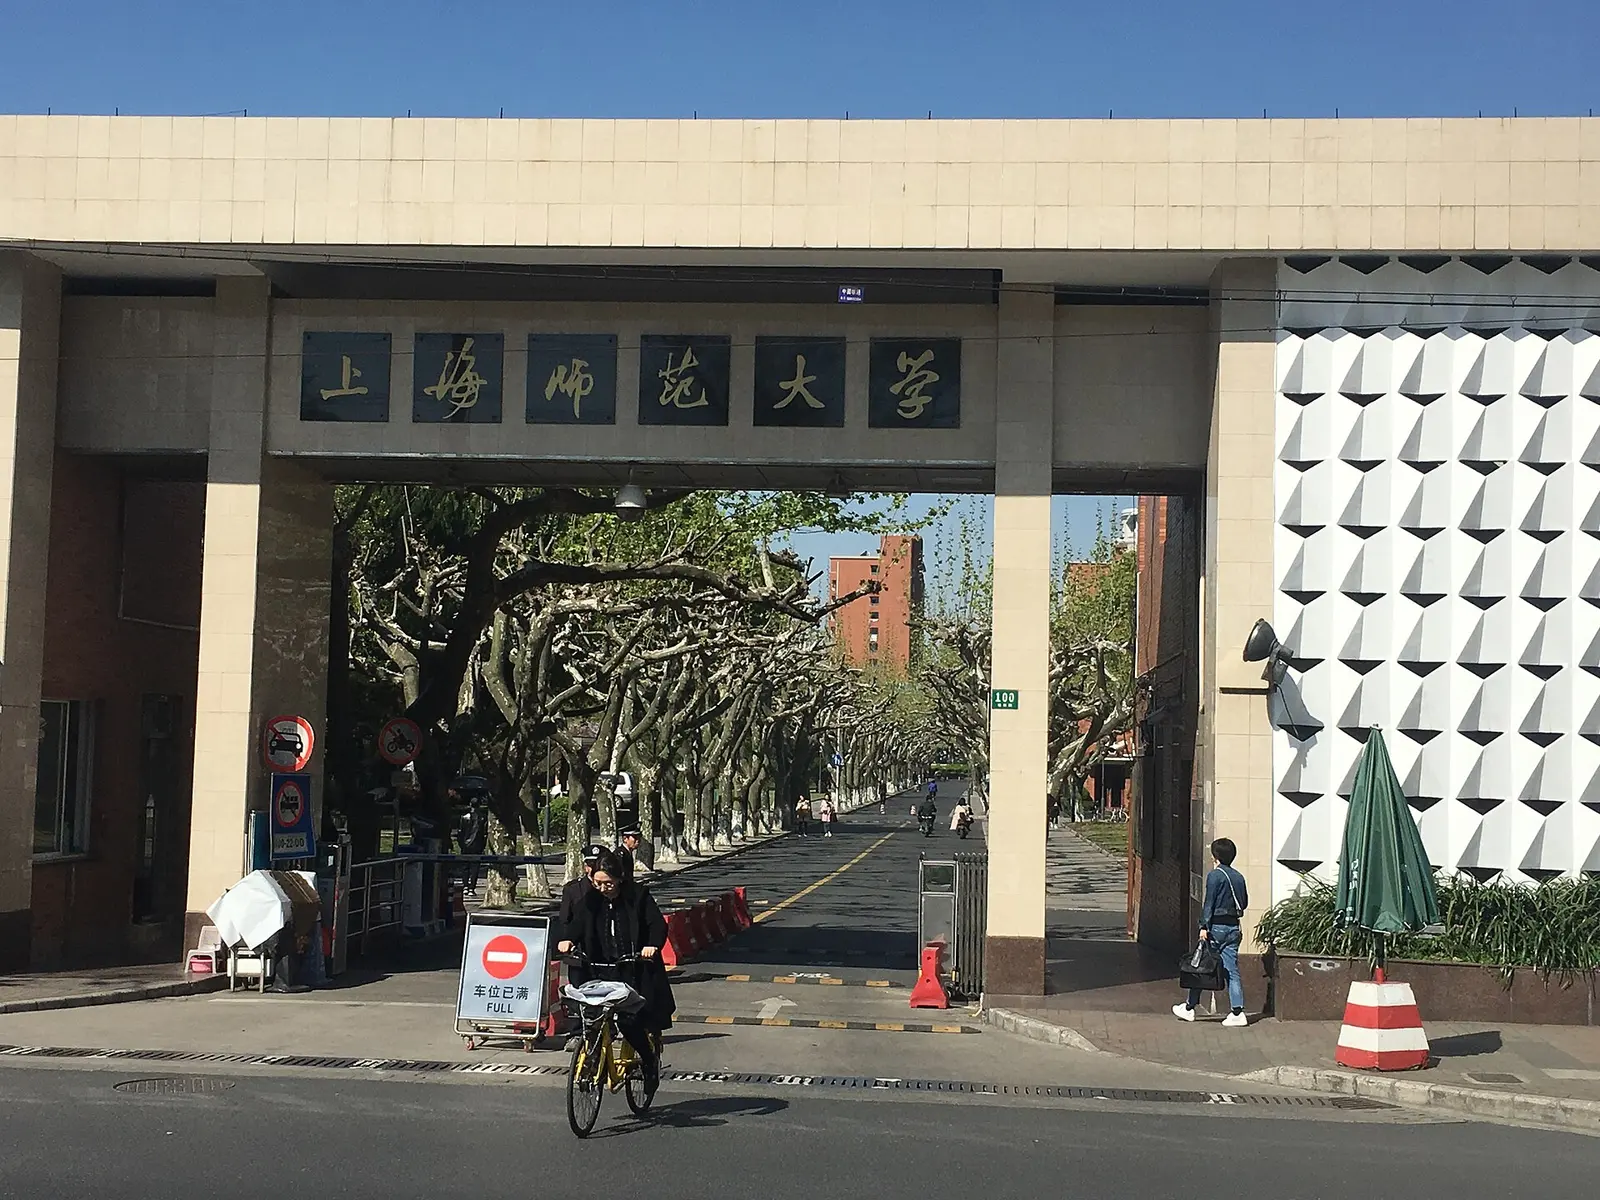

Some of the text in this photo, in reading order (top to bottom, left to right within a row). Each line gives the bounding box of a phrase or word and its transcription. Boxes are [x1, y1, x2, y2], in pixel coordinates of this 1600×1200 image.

[319, 337, 940, 420] 上海师范大学
[995, 691, 1015, 703] 100
[473, 984, 529, 1001] 车位已满
[486, 1002, 514, 1014] FULL
